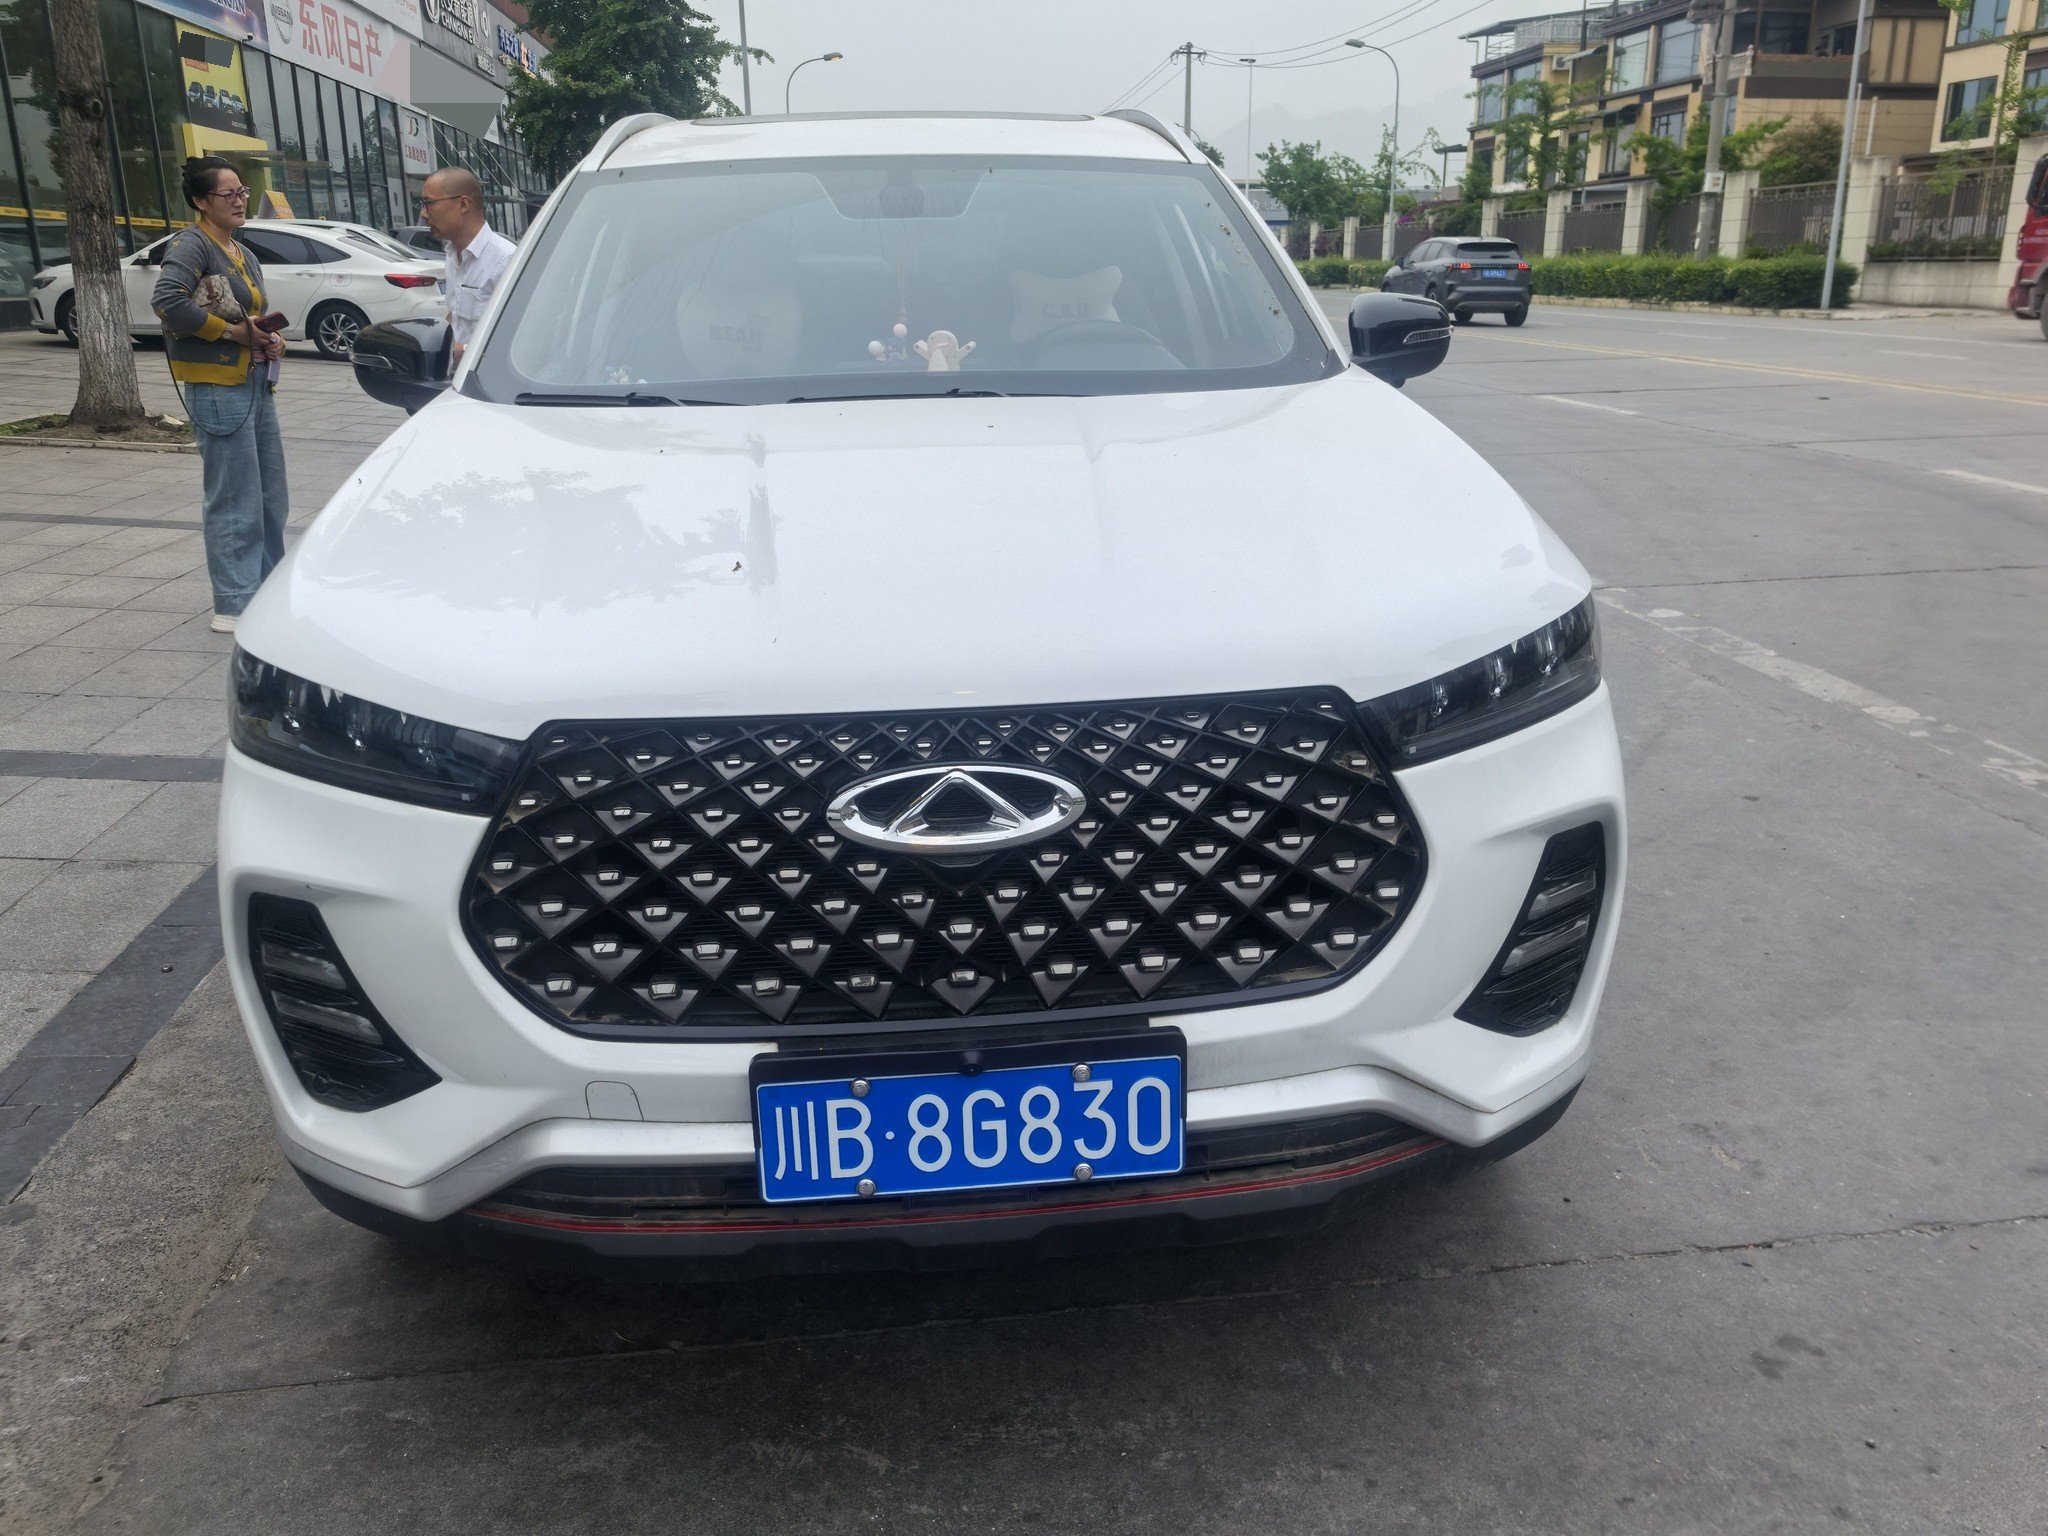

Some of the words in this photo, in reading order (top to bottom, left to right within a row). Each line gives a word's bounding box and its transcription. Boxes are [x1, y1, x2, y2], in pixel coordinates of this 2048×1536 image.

[271, 4, 294, 25] NISSAN
[299, 0, 382, 77] 东风日产
[775, 1077, 1171, 1180] 川B·8G830
